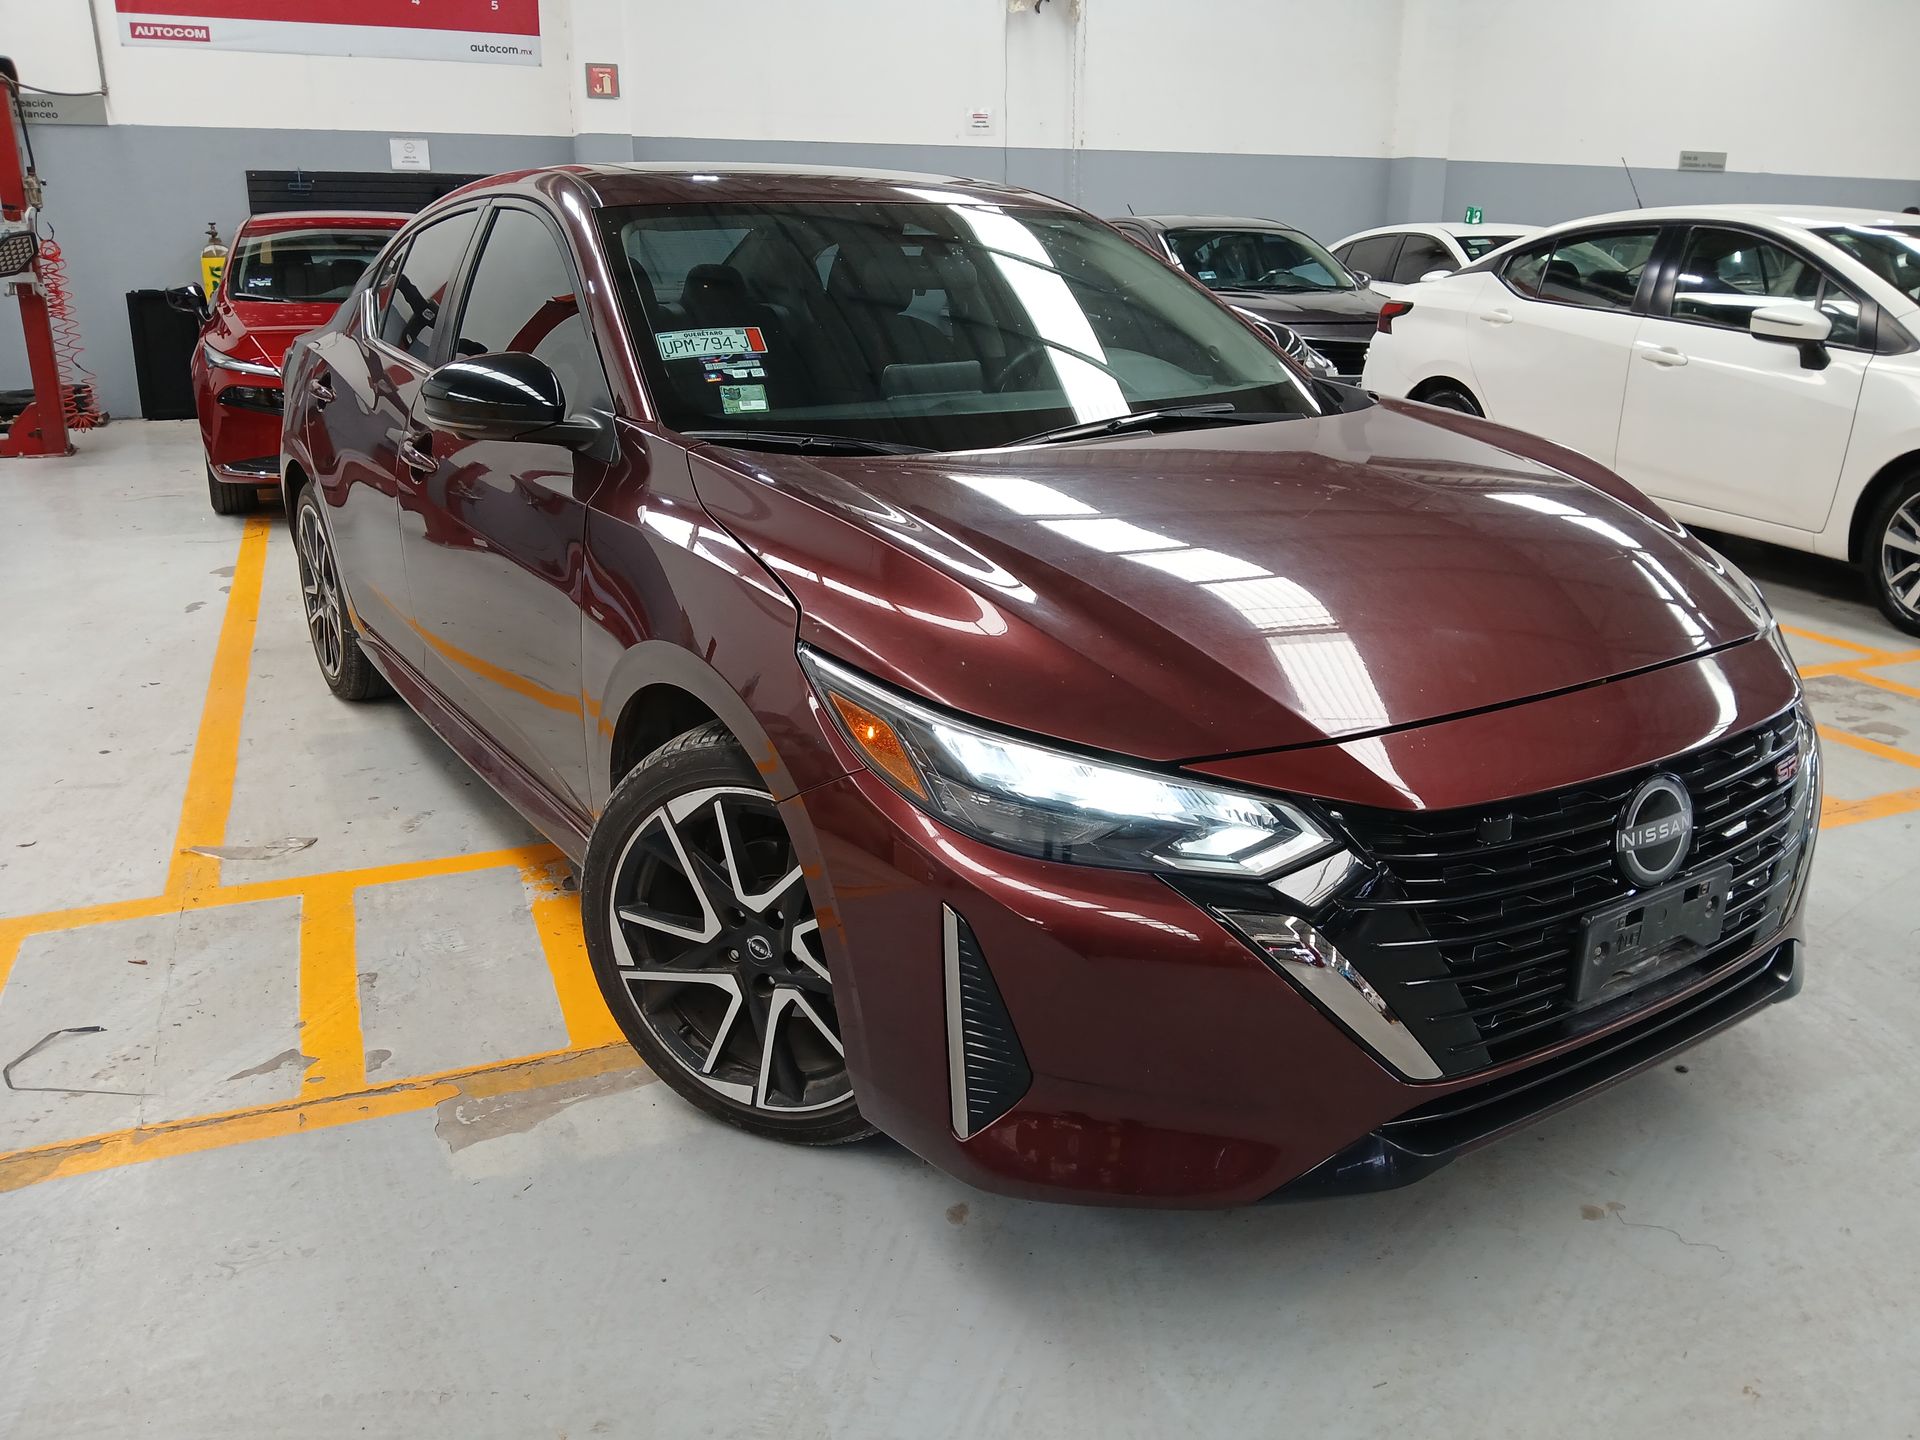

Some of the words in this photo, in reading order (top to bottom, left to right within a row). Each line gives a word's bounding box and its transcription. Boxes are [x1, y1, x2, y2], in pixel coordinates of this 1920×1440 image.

[491, 0, 499, 10] 5
[135, 26, 207, 39] AUTOCOM
[470, 44, 533, 56] autocom.mx
[662, 335, 749, 354] UPM-794-J
[1620, 811, 1691, 849] NISSAN
